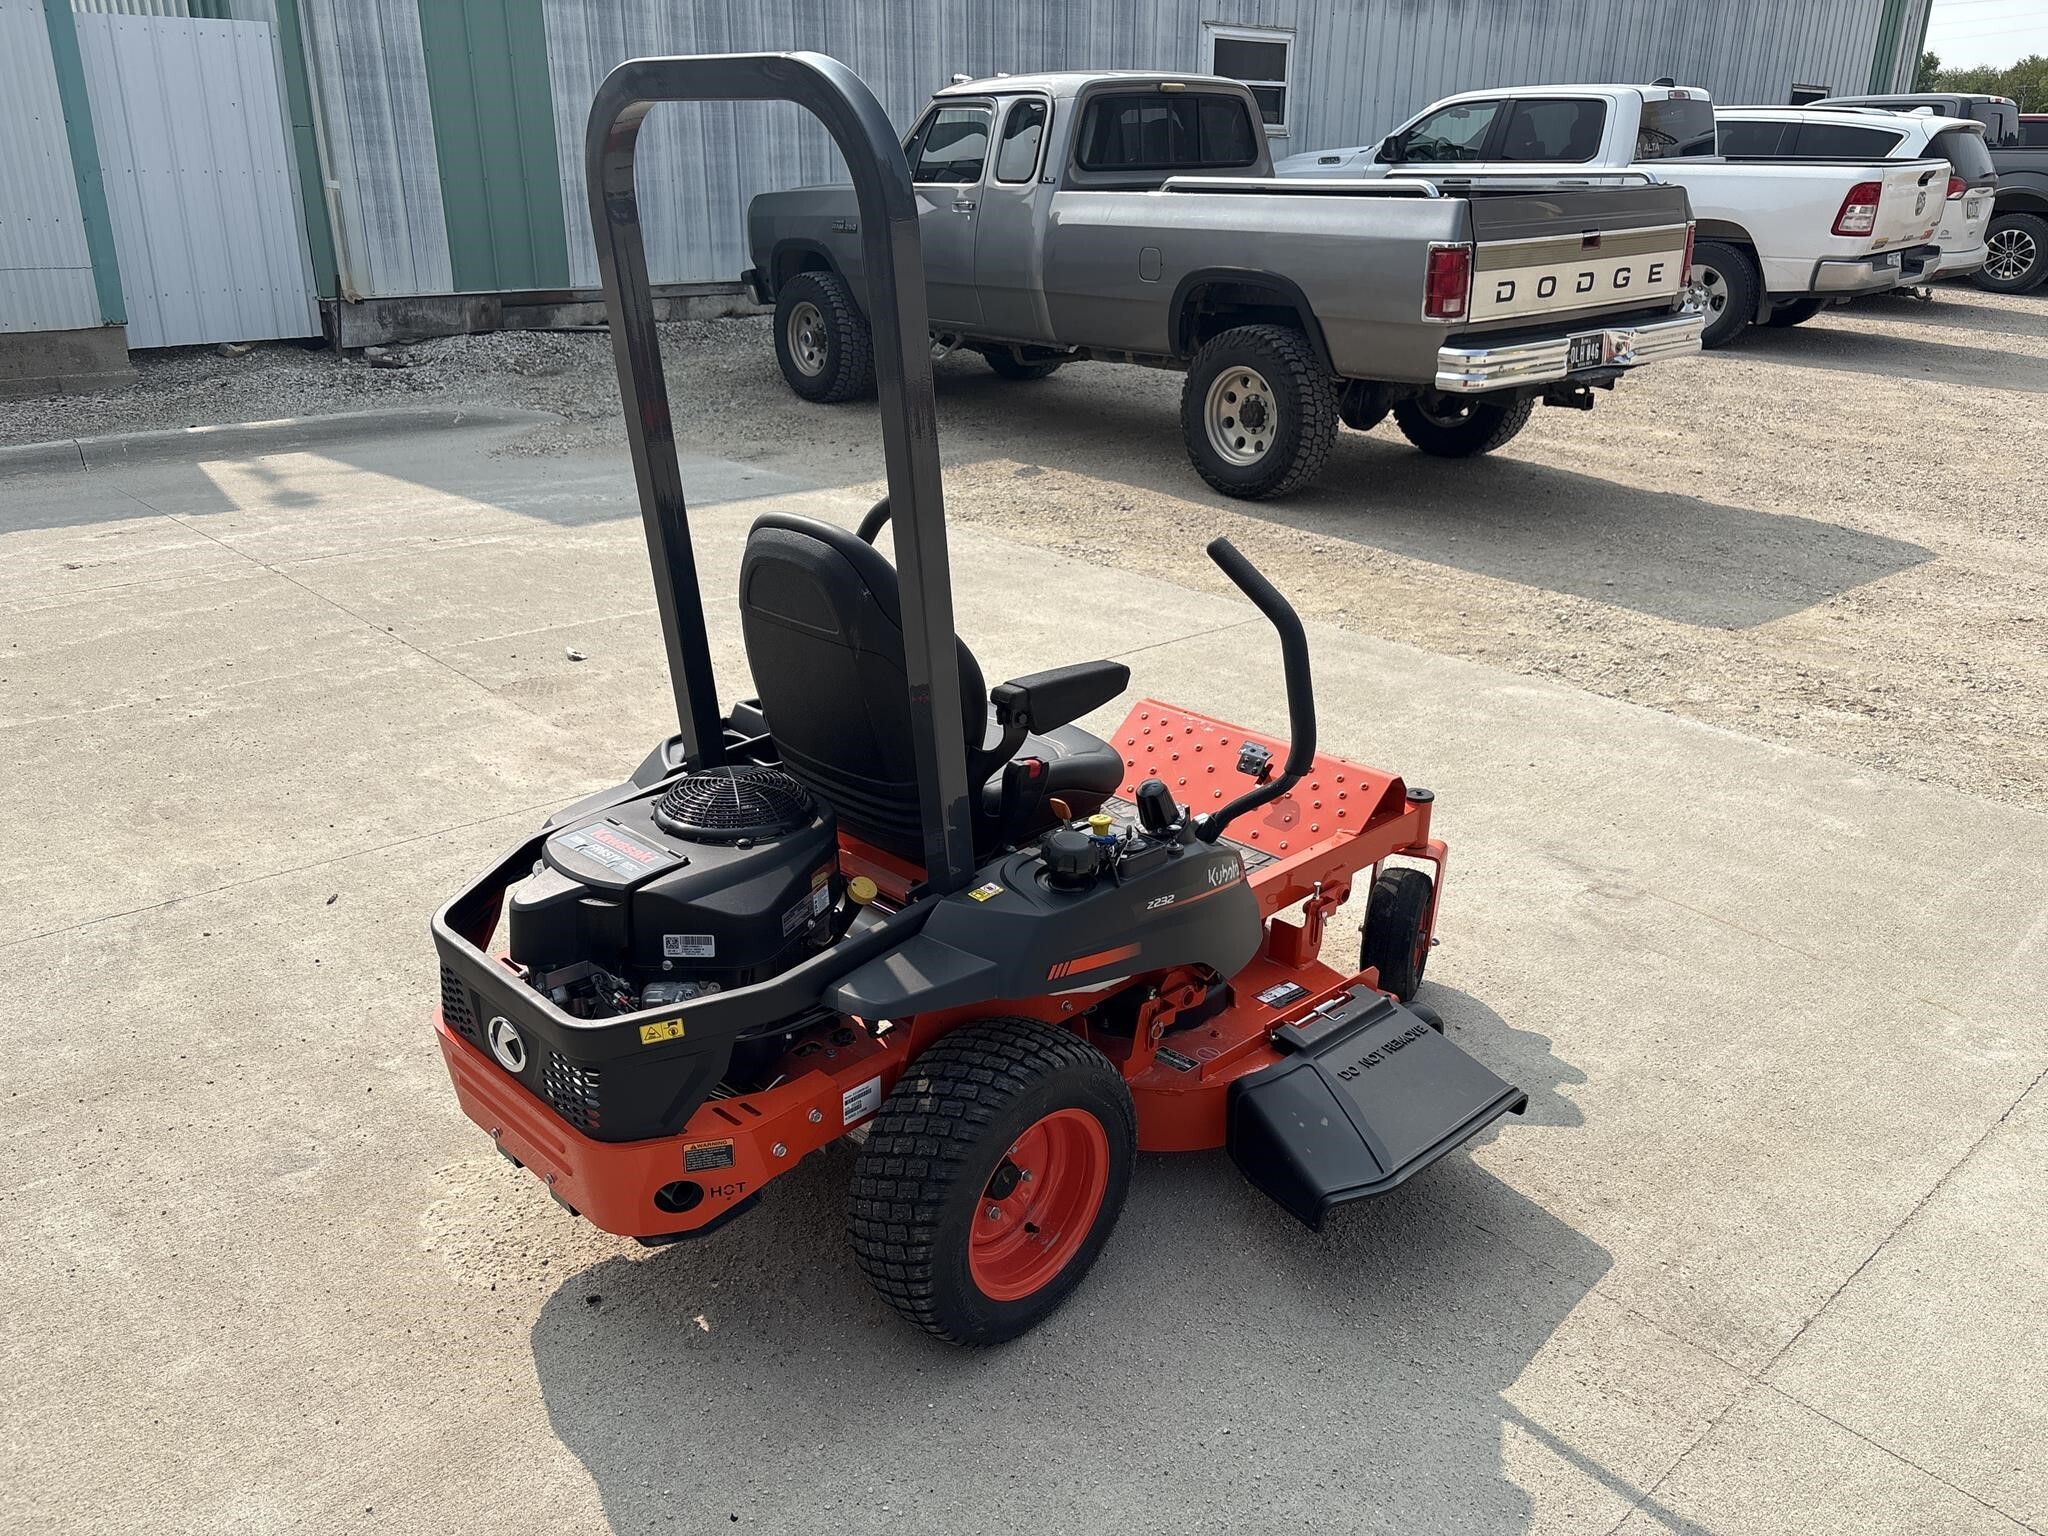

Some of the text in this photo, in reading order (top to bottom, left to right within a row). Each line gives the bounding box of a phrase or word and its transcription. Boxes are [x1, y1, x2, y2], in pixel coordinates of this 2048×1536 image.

[1495, 263, 1664, 303] DODGE
[591, 827, 659, 864] Kawasaki
[1337, 1024, 1429, 1081] DO NOT REMOVE
[697, 1139, 728, 1149] WARNING
[710, 1182, 747, 1199] HOT
